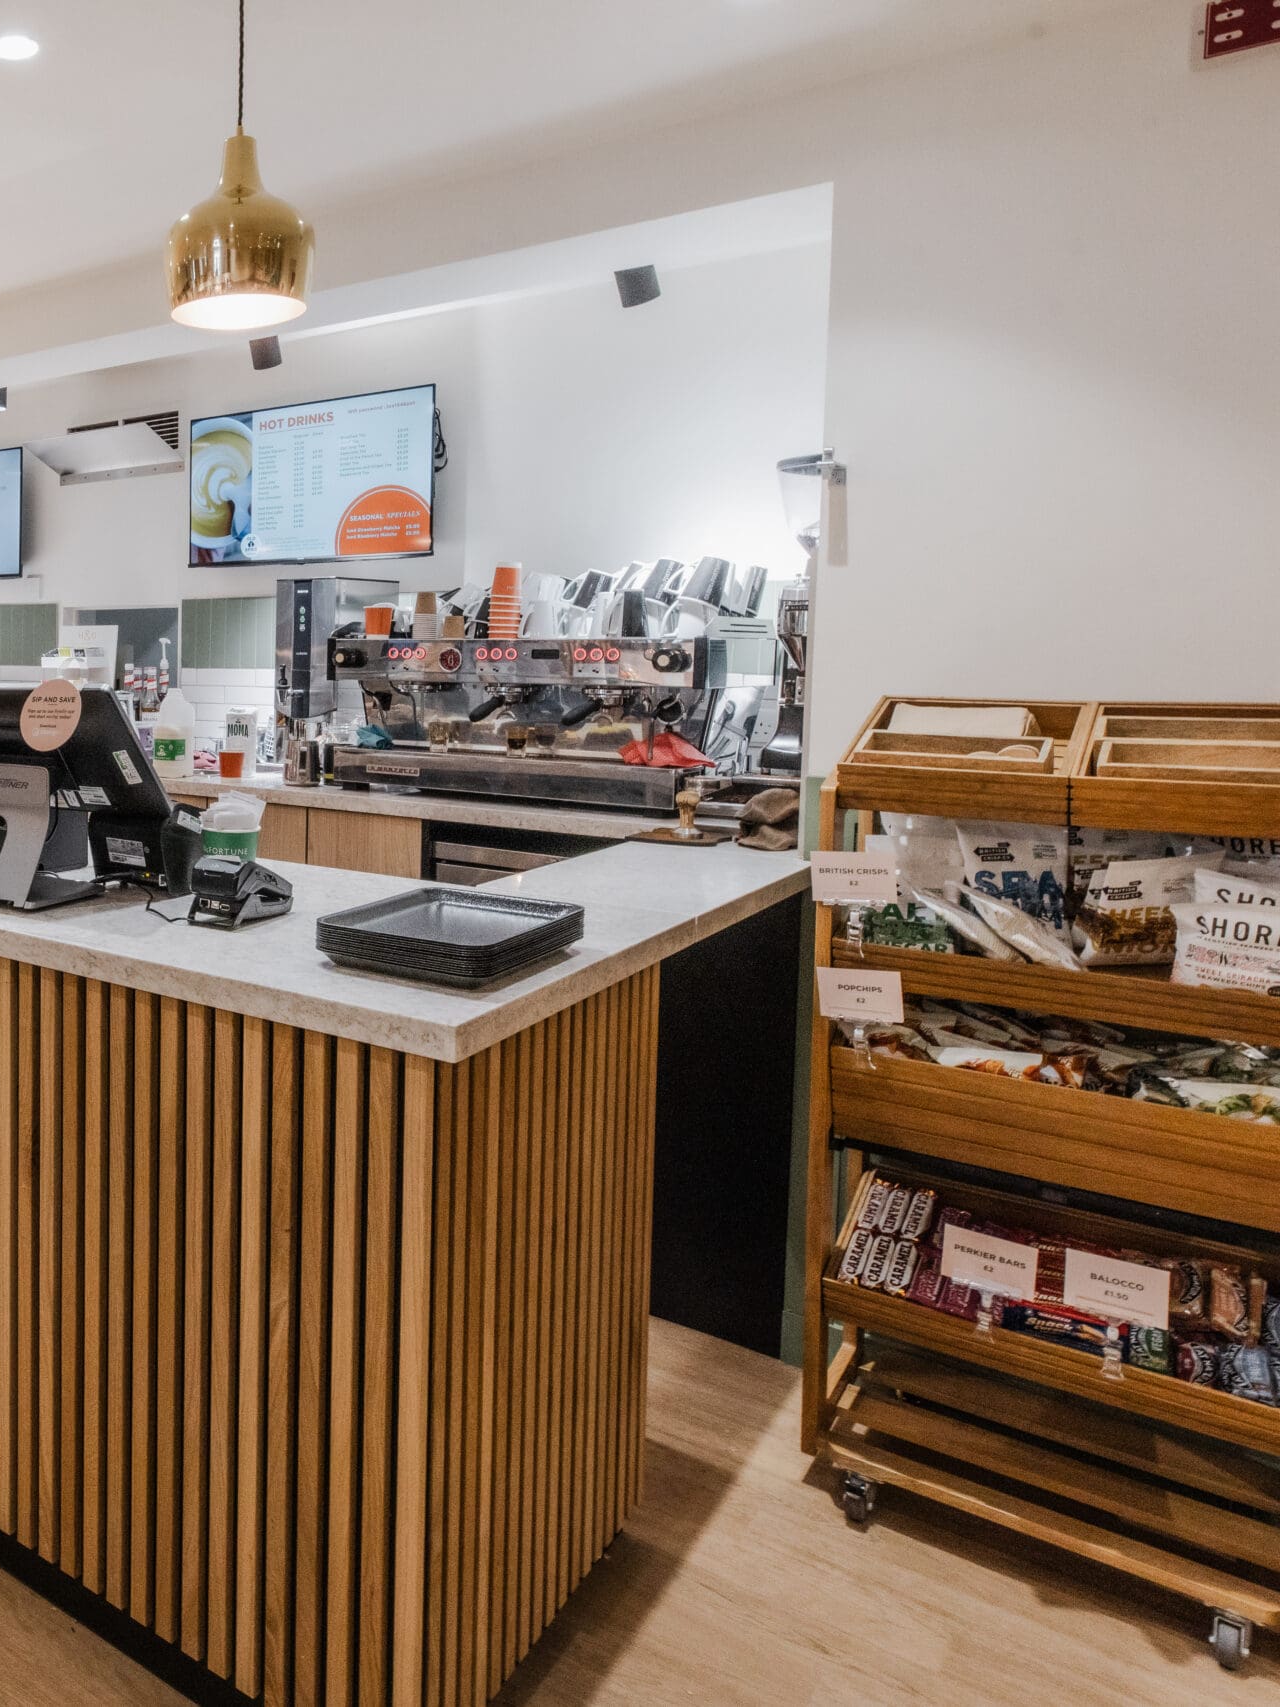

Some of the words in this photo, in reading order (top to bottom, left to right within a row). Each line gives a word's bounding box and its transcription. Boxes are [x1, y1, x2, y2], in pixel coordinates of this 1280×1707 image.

[259, 418, 284, 431] HOT
[287, 411, 334, 428] DRINKS
[350, 513, 385, 522] SEASONAL
[227, 723, 249, 738] MOMA
[208, 847, 249, 856] FORTUNE
[819, 867, 854, 875] BRITISH
[856, 868, 889, 876] CRISPS
[1195, 915, 1280, 947] SHOR
[837, 983, 883, 993] POPCHIPS
[883, 1189, 906, 1232] CARAMEL
[904, 1193, 929, 1236] CARAMEL
[845, 1231, 869, 1275] CARAMEL
[867, 1236, 891, 1282] CARAMEL
[954, 1243, 997, 1261] PERKIER
[998, 1256, 1027, 1270] BARS
[889, 1243, 913, 1287] CARAMEL
[1089, 1272, 1145, 1292] BALOCCO
[1103, 1289, 1129, 1301] £1.50
[1025, 1316, 1074, 1331] Snack
